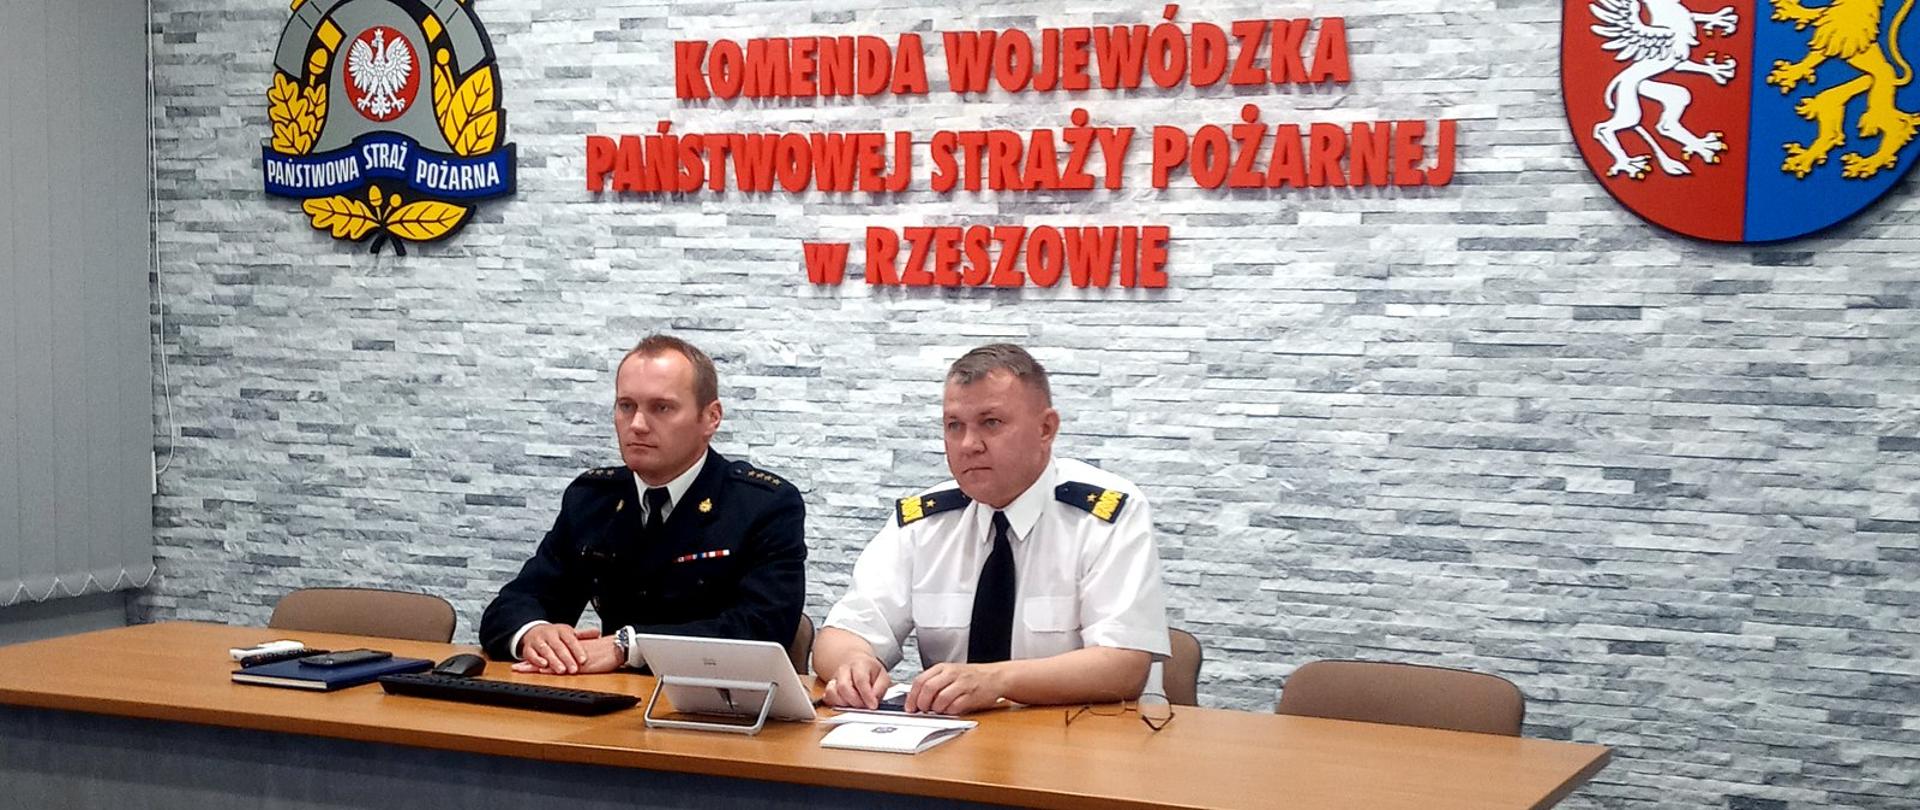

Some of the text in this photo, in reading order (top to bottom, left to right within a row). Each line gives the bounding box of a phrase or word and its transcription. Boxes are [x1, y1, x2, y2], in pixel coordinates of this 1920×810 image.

[675, 4, 1350, 101] KOMENDA WOJEWÓDZKA
[267, 141, 500, 191] PAŃSTWOWA STRAŻ POŻARNA
[586, 104, 1456, 193] PAŃSTWOWEJ STRAŻY POŻARNEJ
[803, 225, 1169, 289] w RZESZOWIE
